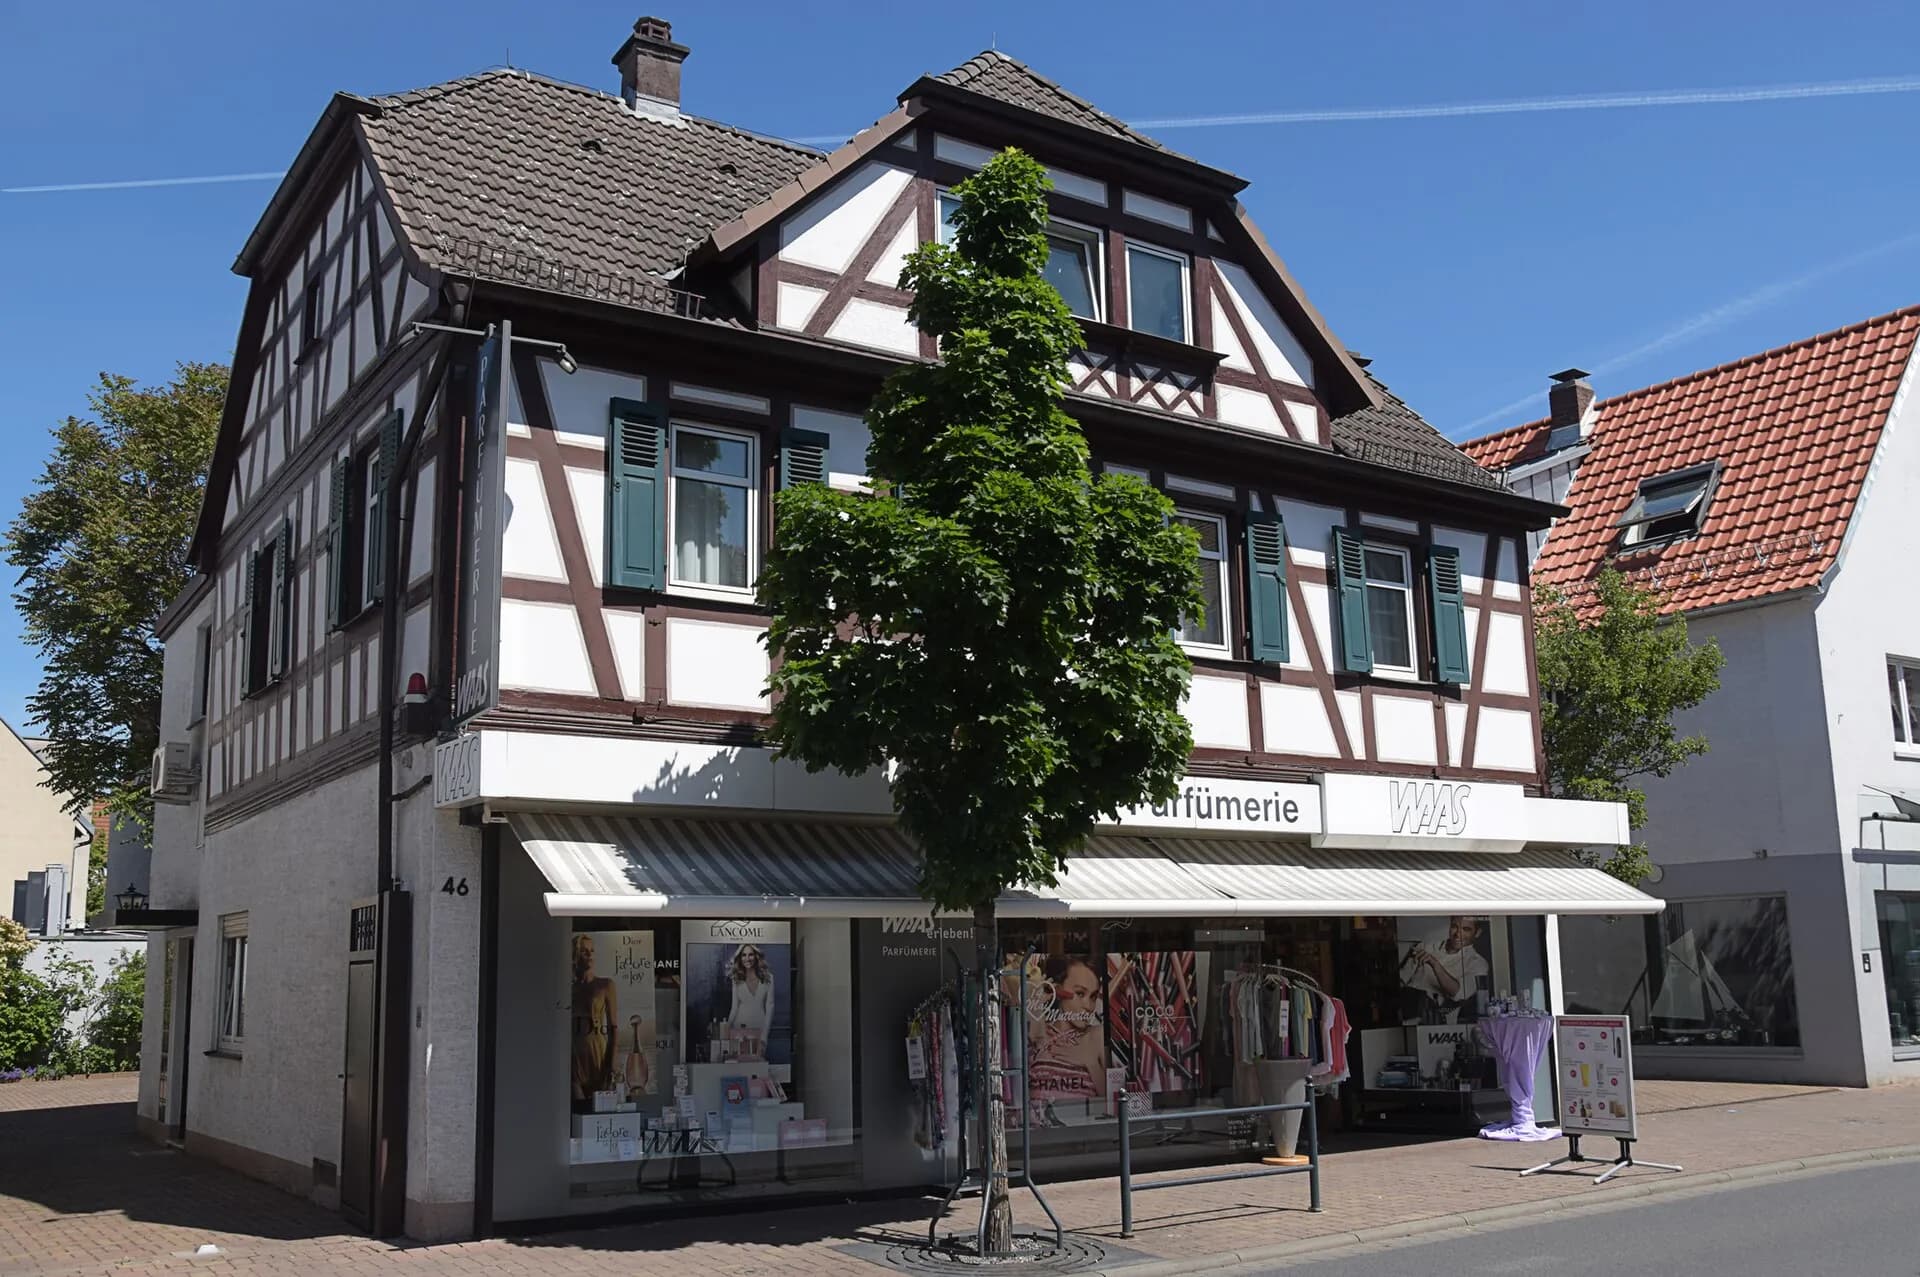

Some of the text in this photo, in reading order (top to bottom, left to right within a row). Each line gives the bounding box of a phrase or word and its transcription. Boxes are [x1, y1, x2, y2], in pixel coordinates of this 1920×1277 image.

[470, 355, 489, 656] PARFÜMERIE
[456, 657, 489, 718] WAAS
[436, 735, 480, 804] WAAS
[1129, 786, 1299, 823] arfümerie
[1389, 780, 1472, 836] WAAS
[441, 876, 469, 897] 46
[622, 935, 642, 946] Dior
[926, 927, 974, 939] erleben!
[1135, 1005, 1175, 1018] COCO
[1428, 1031, 1464, 1044] WAAS
[1029, 1077, 1089, 1091] CHANEL
